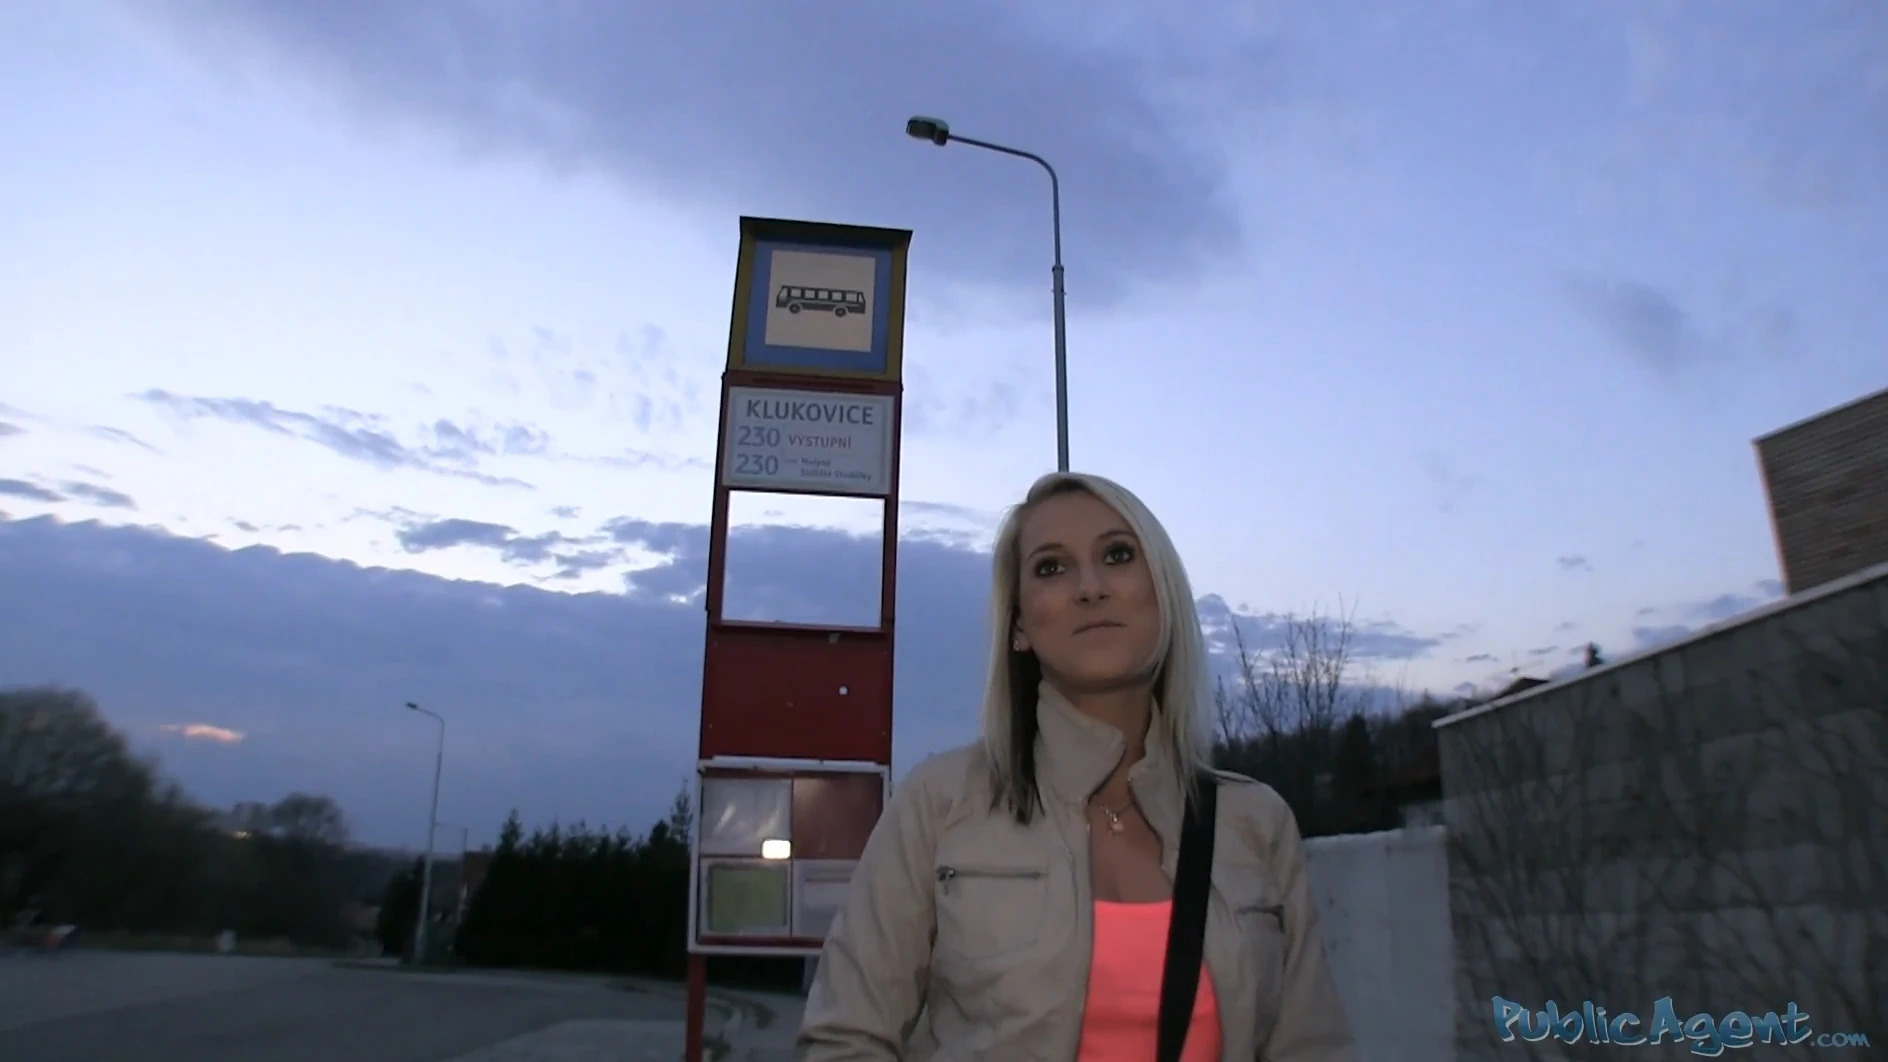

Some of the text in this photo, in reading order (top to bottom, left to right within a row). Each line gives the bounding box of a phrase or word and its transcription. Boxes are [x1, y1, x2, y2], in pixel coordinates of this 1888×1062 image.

[746, 399, 874, 425] KLUKOVICE
[738, 425, 781, 447] 230
[735, 453, 779, 475] 230
